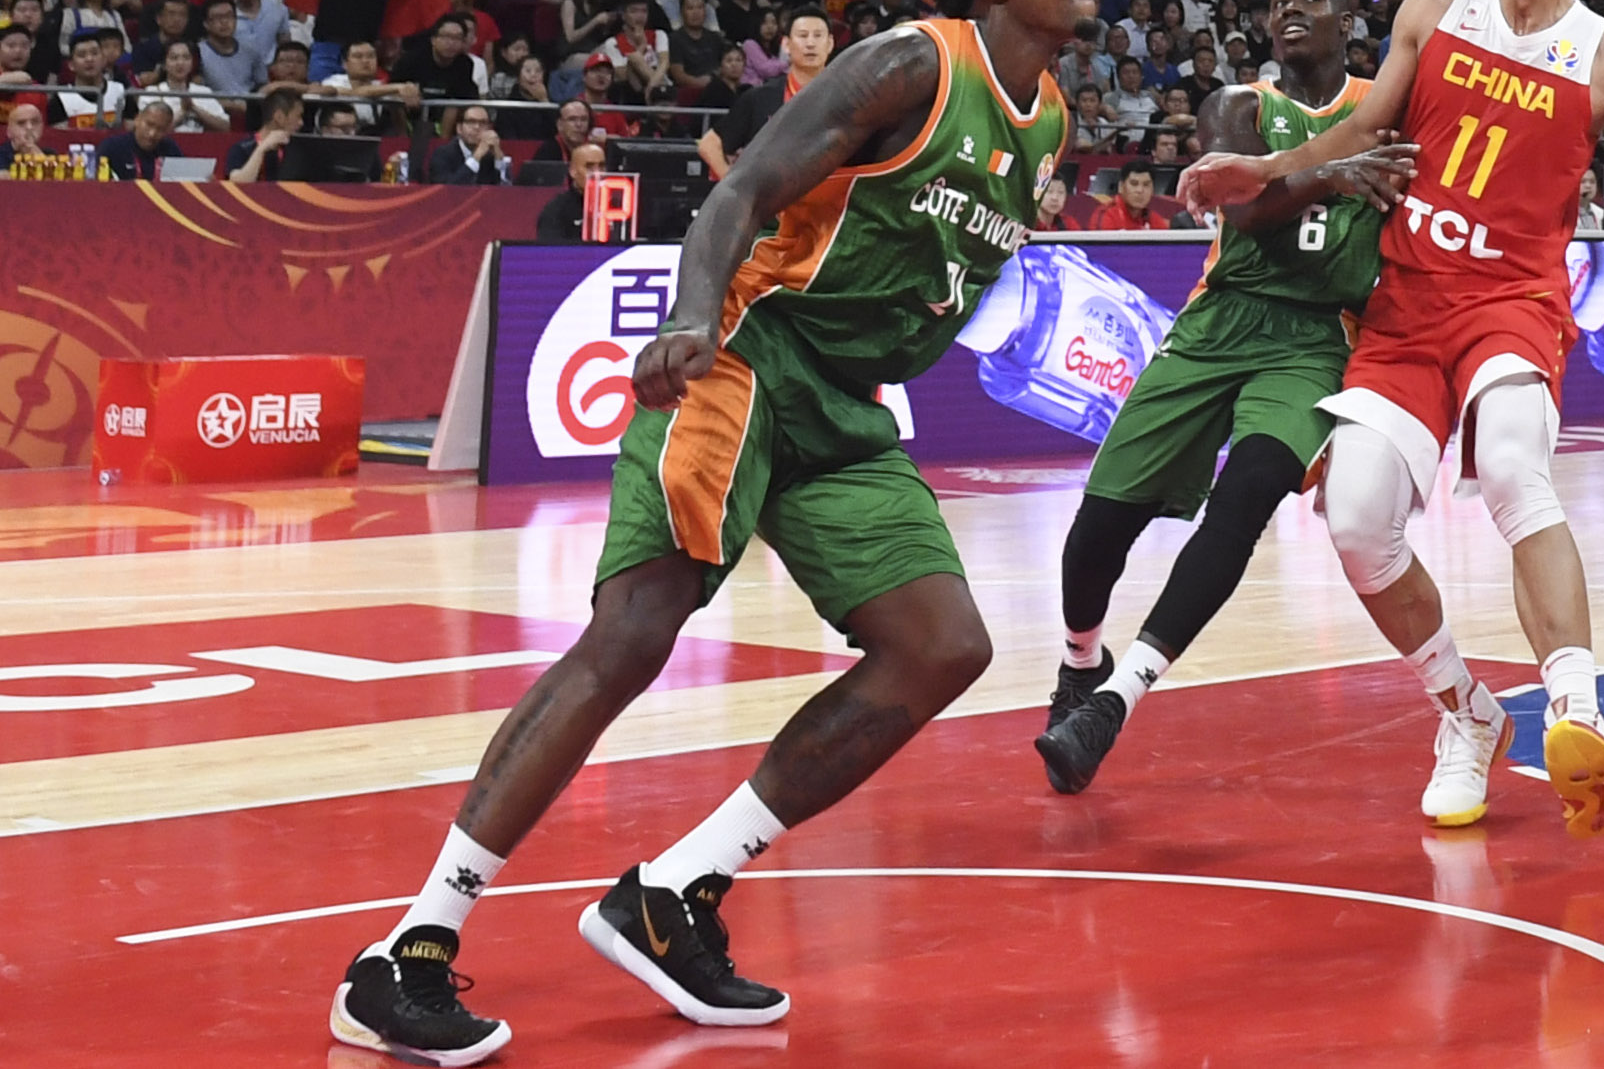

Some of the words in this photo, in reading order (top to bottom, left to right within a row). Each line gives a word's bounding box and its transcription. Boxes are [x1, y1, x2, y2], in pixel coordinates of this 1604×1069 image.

[1442, 51, 1556, 120] CHINA
[1439, 114, 1508, 199] 11
[909, 176, 969, 225] CÔTE
[1298, 203, 1328, 251] 6
[1403, 195, 1504, 260] TCL
[1065, 335, 1136, 399] Ganten
[249, 429, 321, 445] VENUCIA
[250, 393, 322, 430] 启辰
